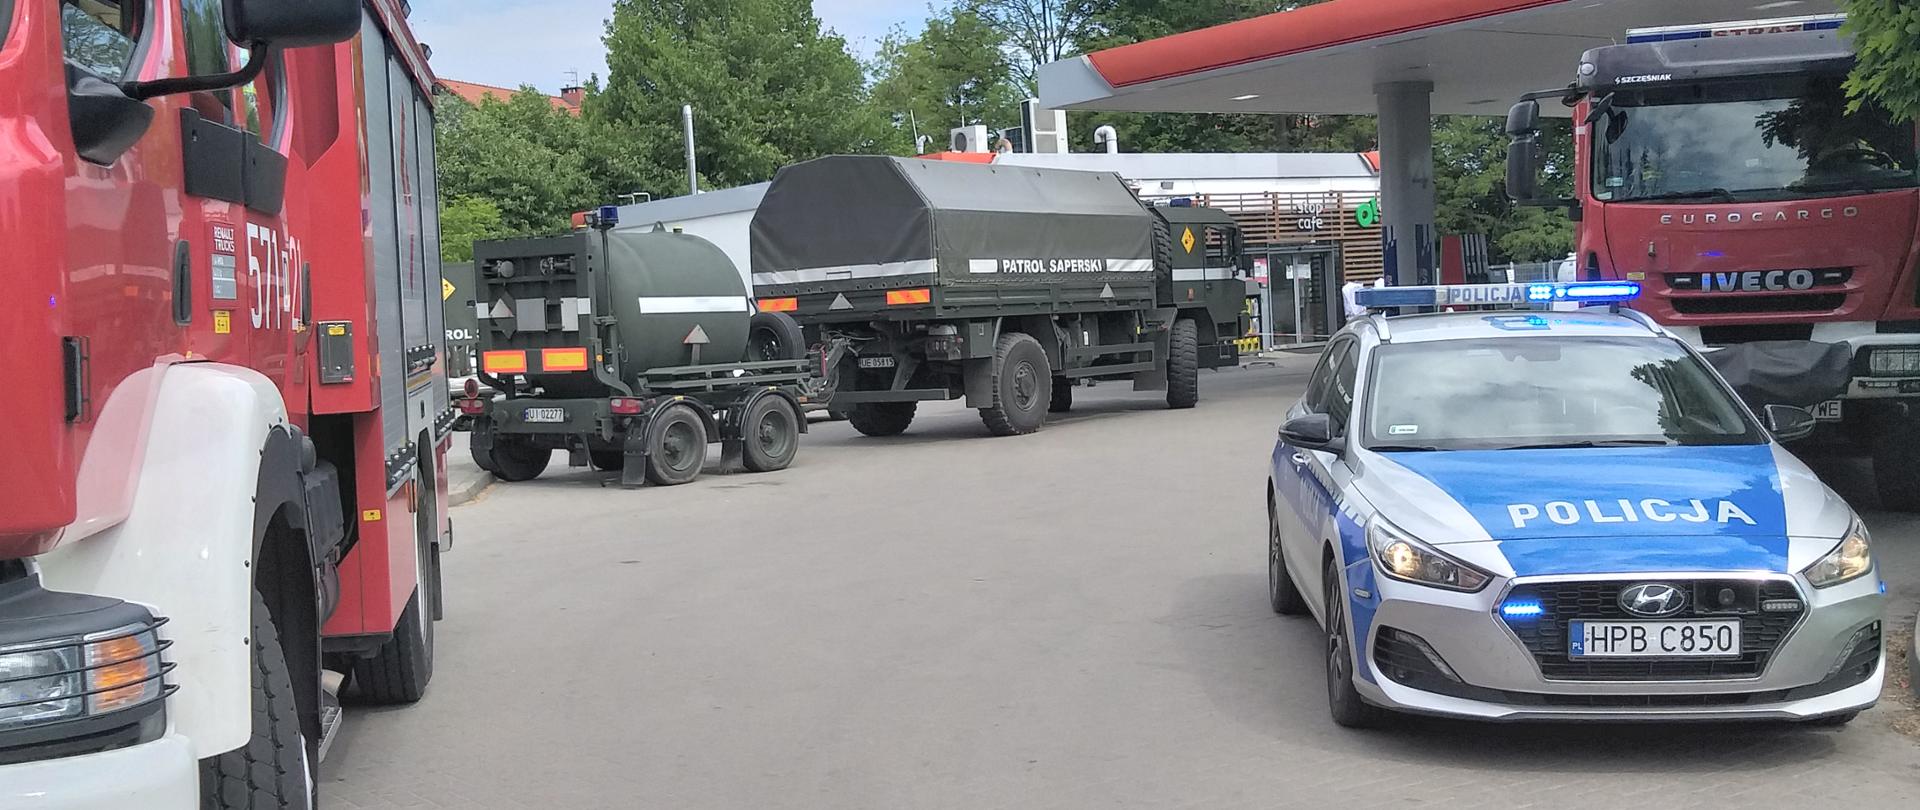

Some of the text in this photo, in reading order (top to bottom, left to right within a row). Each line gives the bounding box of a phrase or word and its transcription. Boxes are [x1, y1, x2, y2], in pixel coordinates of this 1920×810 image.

[1296, 202, 1324, 217] stop
[1660, 206, 1858, 225] EUROCARGO
[1298, 216, 1324, 232] cafe
[213, 226, 235, 240] RENAULT
[214, 239, 236, 252] TRUCKS
[1003, 259, 1102, 273] PATROL SAPERSKI
[1701, 269, 1815, 293] IVECO
[1453, 286, 1522, 303] POLICJA
[1507, 498, 1757, 528] POLICJA
[1572, 625, 1733, 653] PL HPB C850
